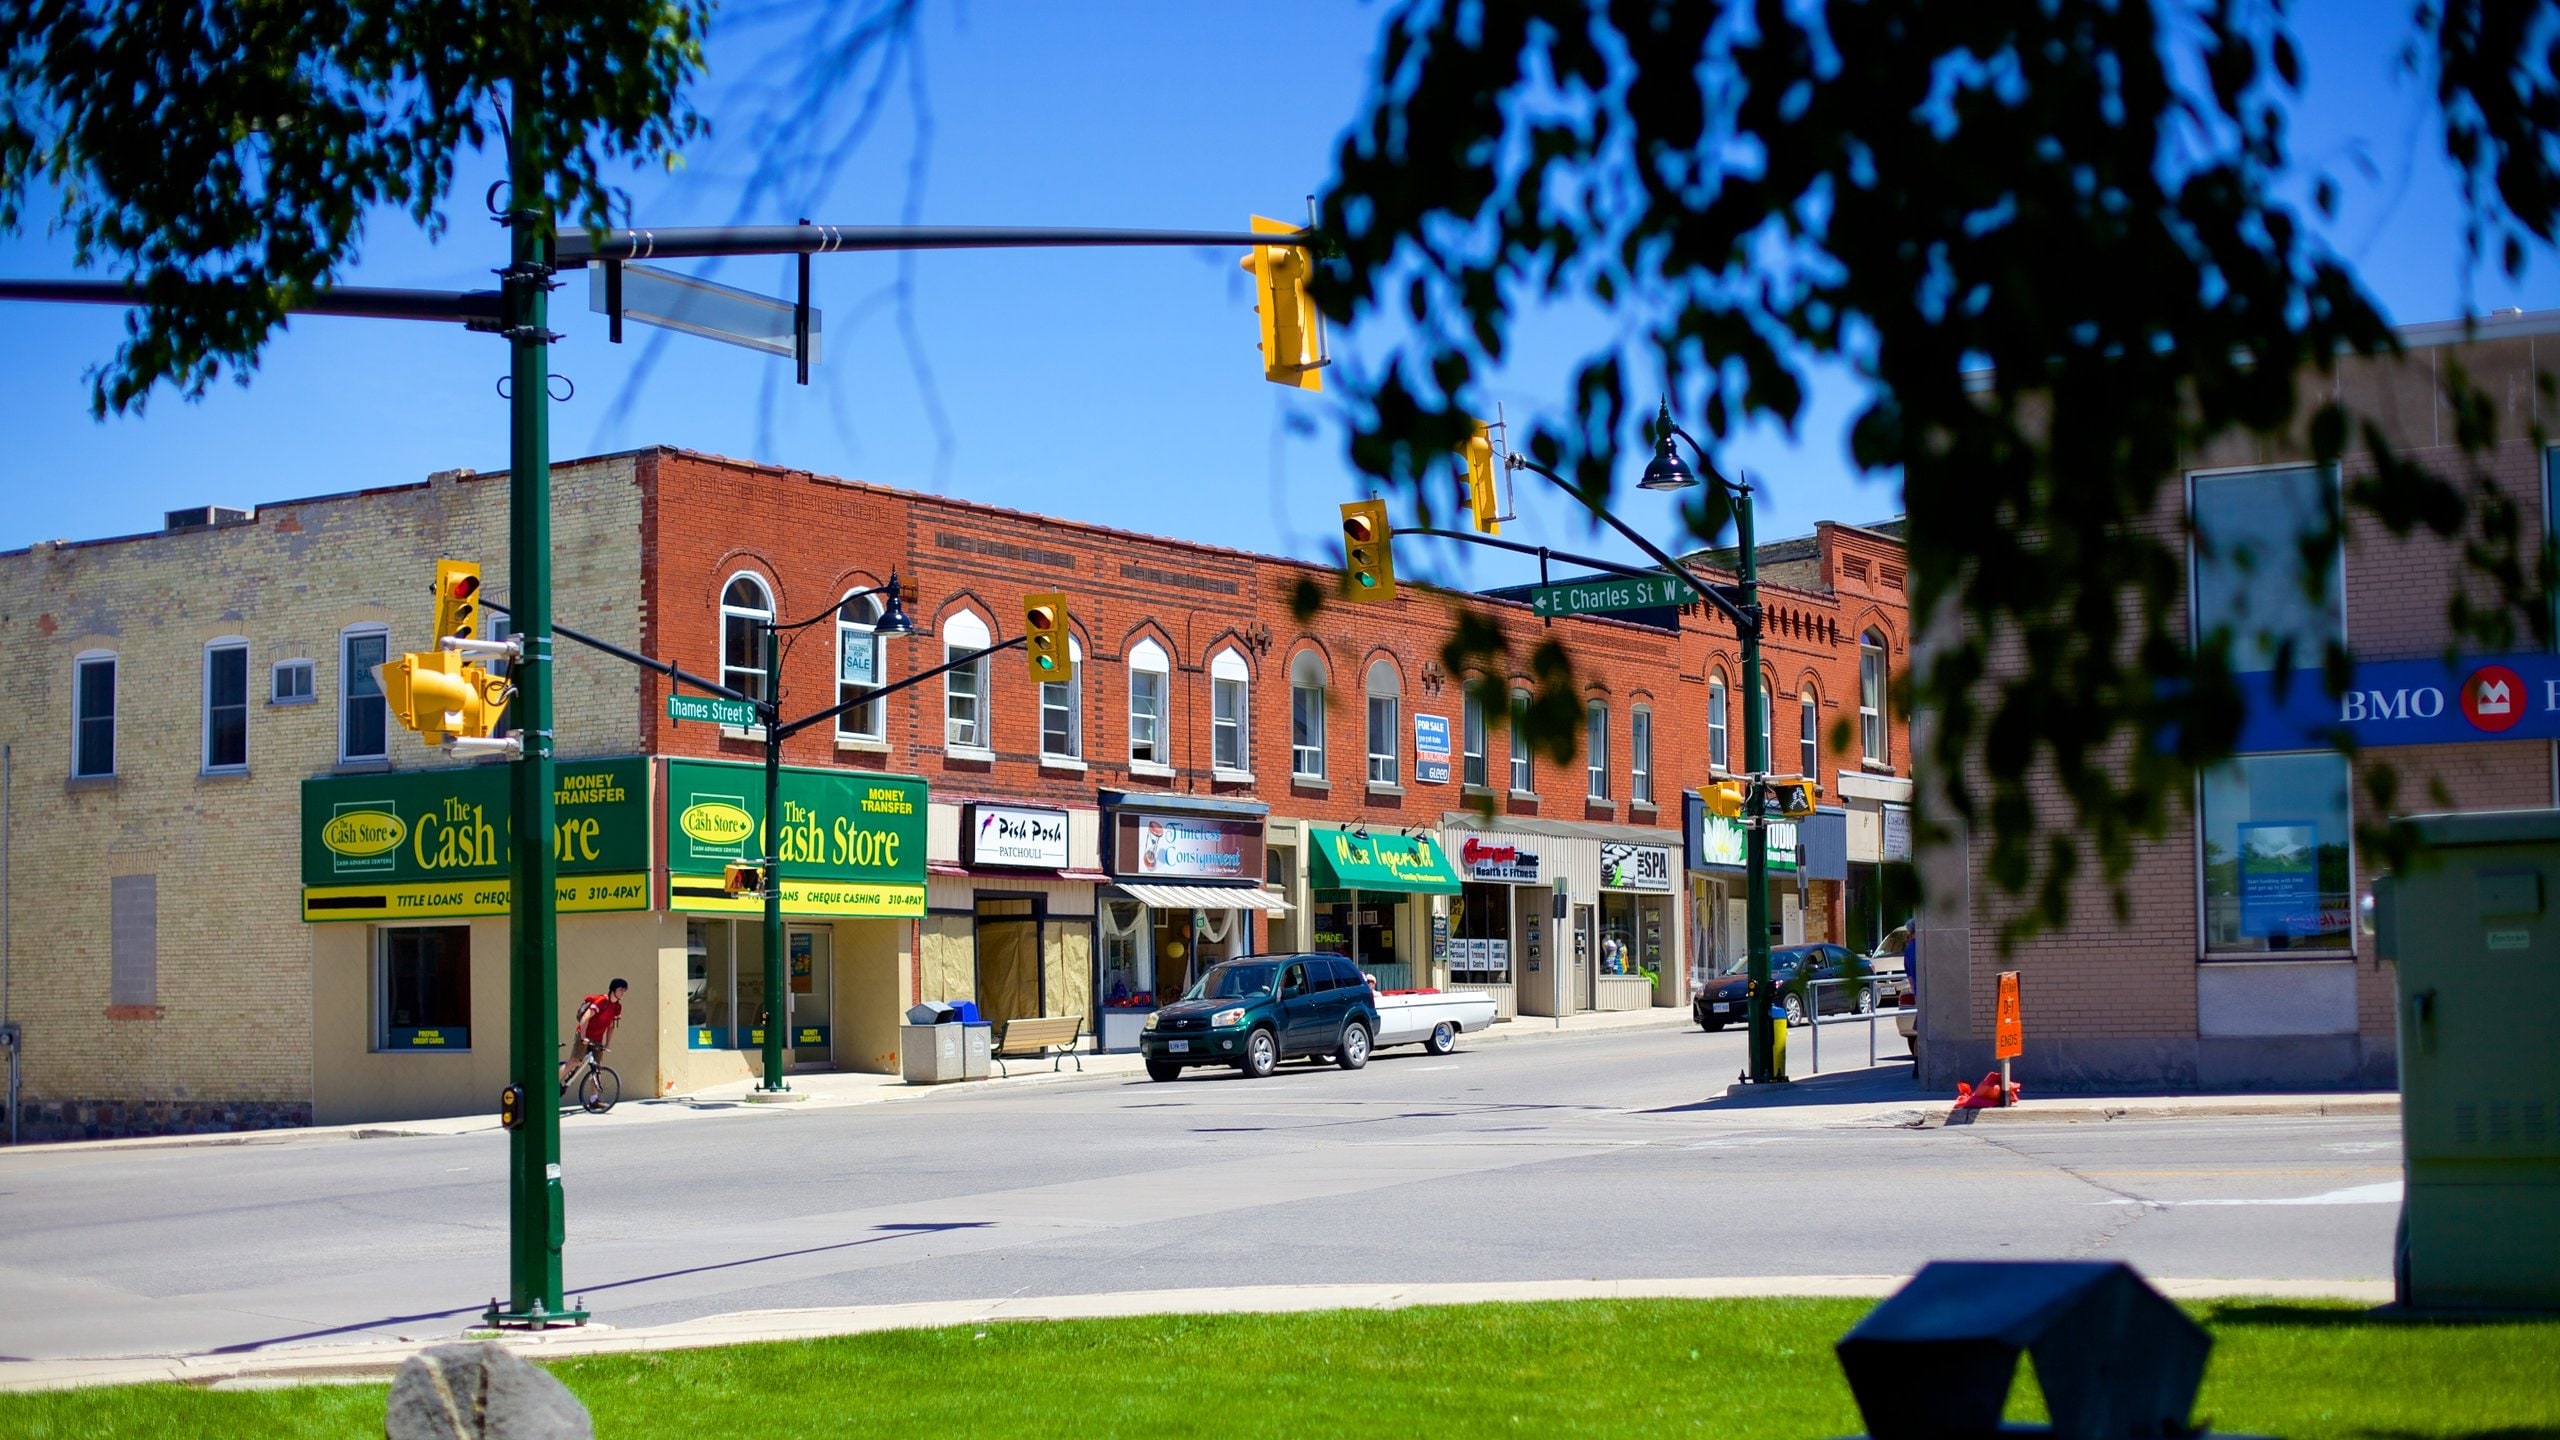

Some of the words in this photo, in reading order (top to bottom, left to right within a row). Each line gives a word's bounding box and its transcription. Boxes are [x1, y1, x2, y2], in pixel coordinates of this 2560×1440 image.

[1553, 591, 1563, 611] E
[1570, 586, 1629, 610] Charles
[1637, 582, 1653, 604] St
[1663, 580, 1676, 601] W
[847, 656, 870, 669] SALE
[670, 697, 708, 718] Thames
[712, 702, 743, 722] Street
[747, 706, 754, 723] S
[2339, 687, 2445, 722] BMO
[1417, 720, 1430, 730] FOR
[1430, 721, 1444, 733] SALE
[563, 774, 614, 790] MONEY
[553, 788, 625, 805] TRANSFER
[868, 788, 905, 802] MONEY
[443, 796, 470, 822] The
[784, 800, 806, 823] The
[861, 800, 912, 815] TRANSFER
[331, 823, 356, 844] Cash
[360, 824, 388, 843] Store
[689, 813, 712, 832] Cash
[714, 814, 739, 833] Store
[999, 817, 1027, 841] Pish
[1032, 820, 1061, 842] Posh
[1165, 822, 1221, 843] Timeless
[414, 804, 498, 870] Cash
[832, 816, 900, 867] Store
[1766, 823, 1797, 850] TUDIO
[999, 846, 1042, 859] PATCHOULI
[1165, 846, 1241, 872] Consignment
[1336, 834, 1370, 866] Miss
[1372, 838, 1434, 877] Ingersoll
[1637, 850, 1645, 877] THE
[1476, 866, 1501, 877] Health
[1510, 867, 1537, 879] Fitness
[1645, 851, 1667, 879] SPA
[397, 894, 427, 907] TITLE
[427, 893, 463, 906] LOANS
[588, 885, 642, 900] 310-4PAY
[806, 891, 843, 905] CHEQUE
[843, 893, 880, 905] CASHING
[888, 895, 923, 905] 310-4PAY
[2001, 1033, 2018, 1048] ENDS
